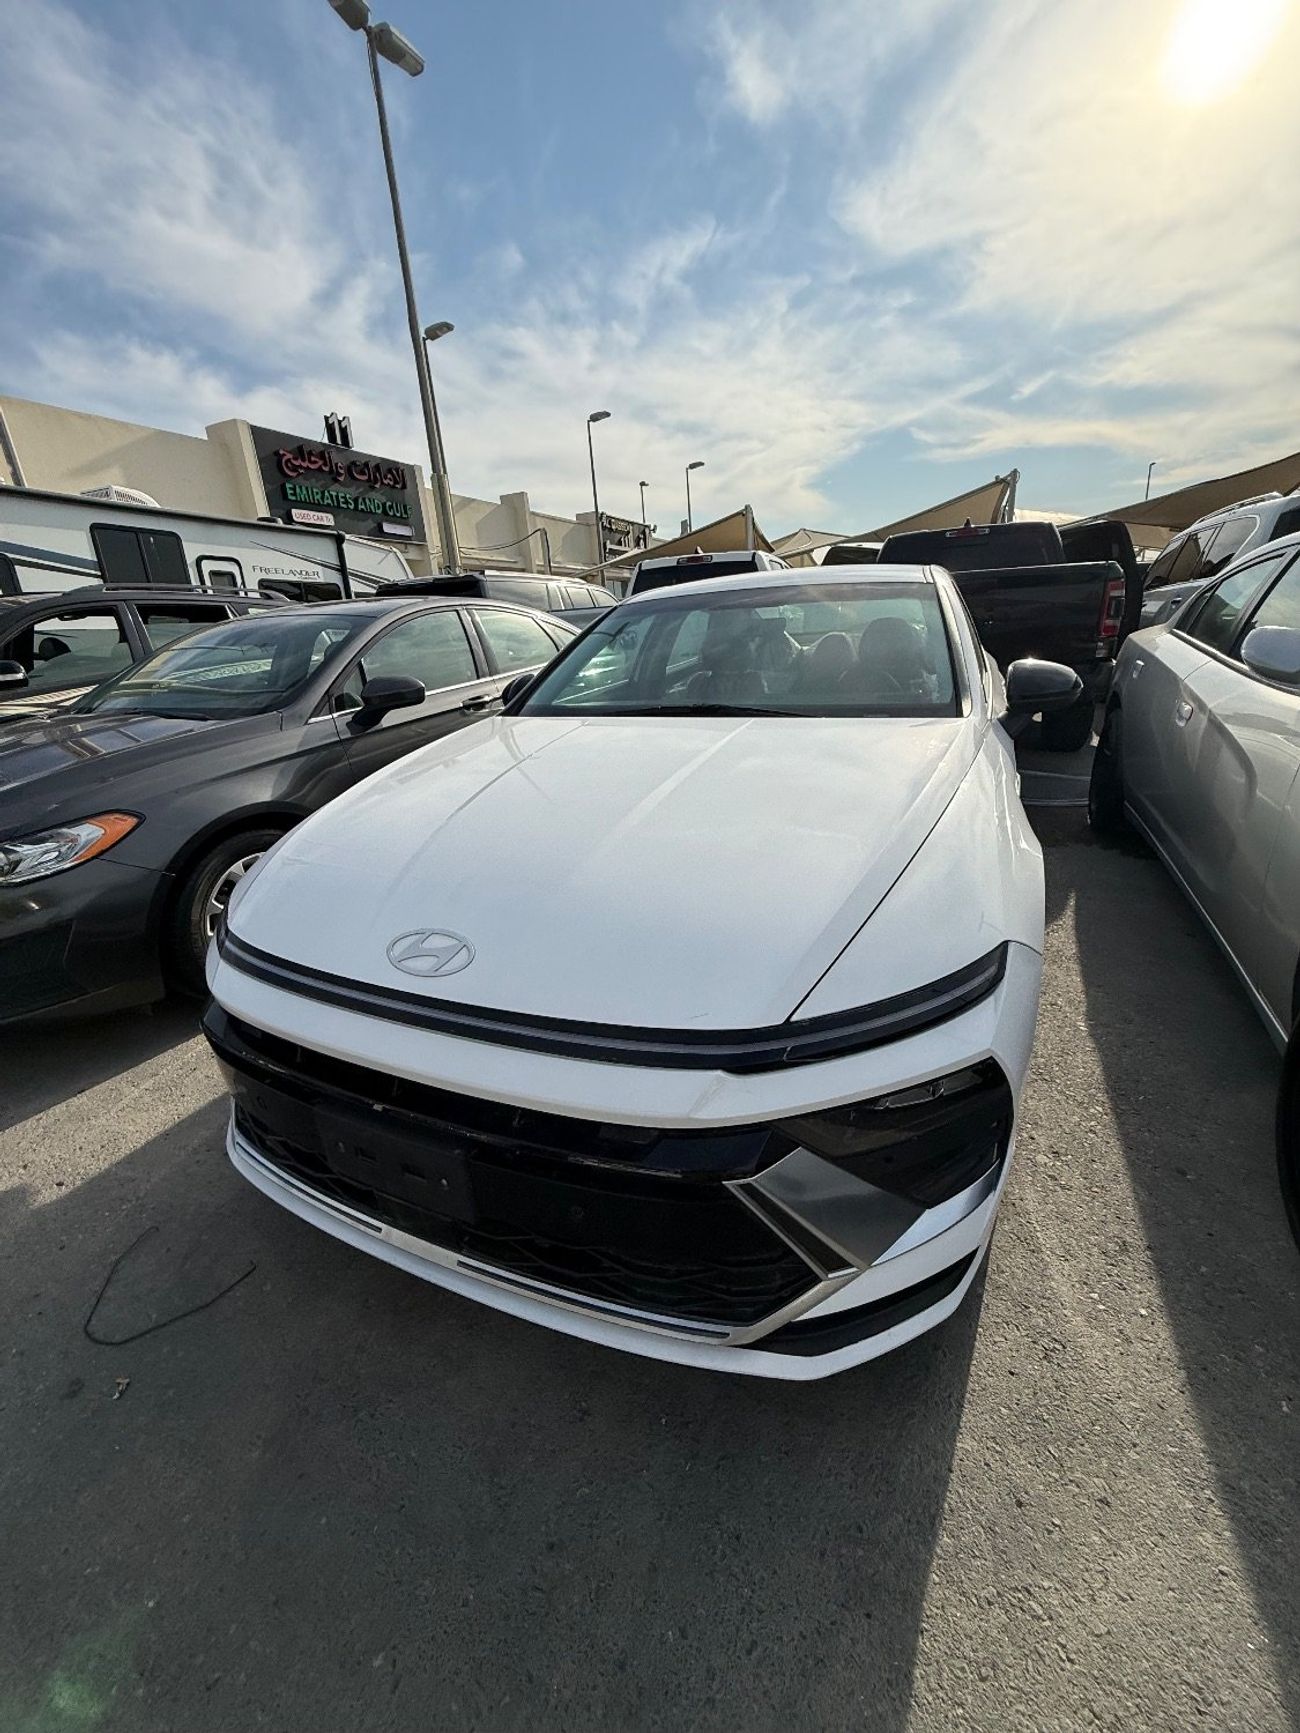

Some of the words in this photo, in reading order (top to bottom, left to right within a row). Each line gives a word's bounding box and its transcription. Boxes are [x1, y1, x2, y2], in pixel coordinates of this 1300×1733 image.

[324, 412, 354, 449] 11
[284, 483, 354, 509] EMIRATES
[358, 498, 382, 514] AND
[385, 501, 412, 519] GULF
[294, 512, 311, 520] USED
[312, 514, 324, 523] CAR
[252, 565, 320, 578] FREELANDER
